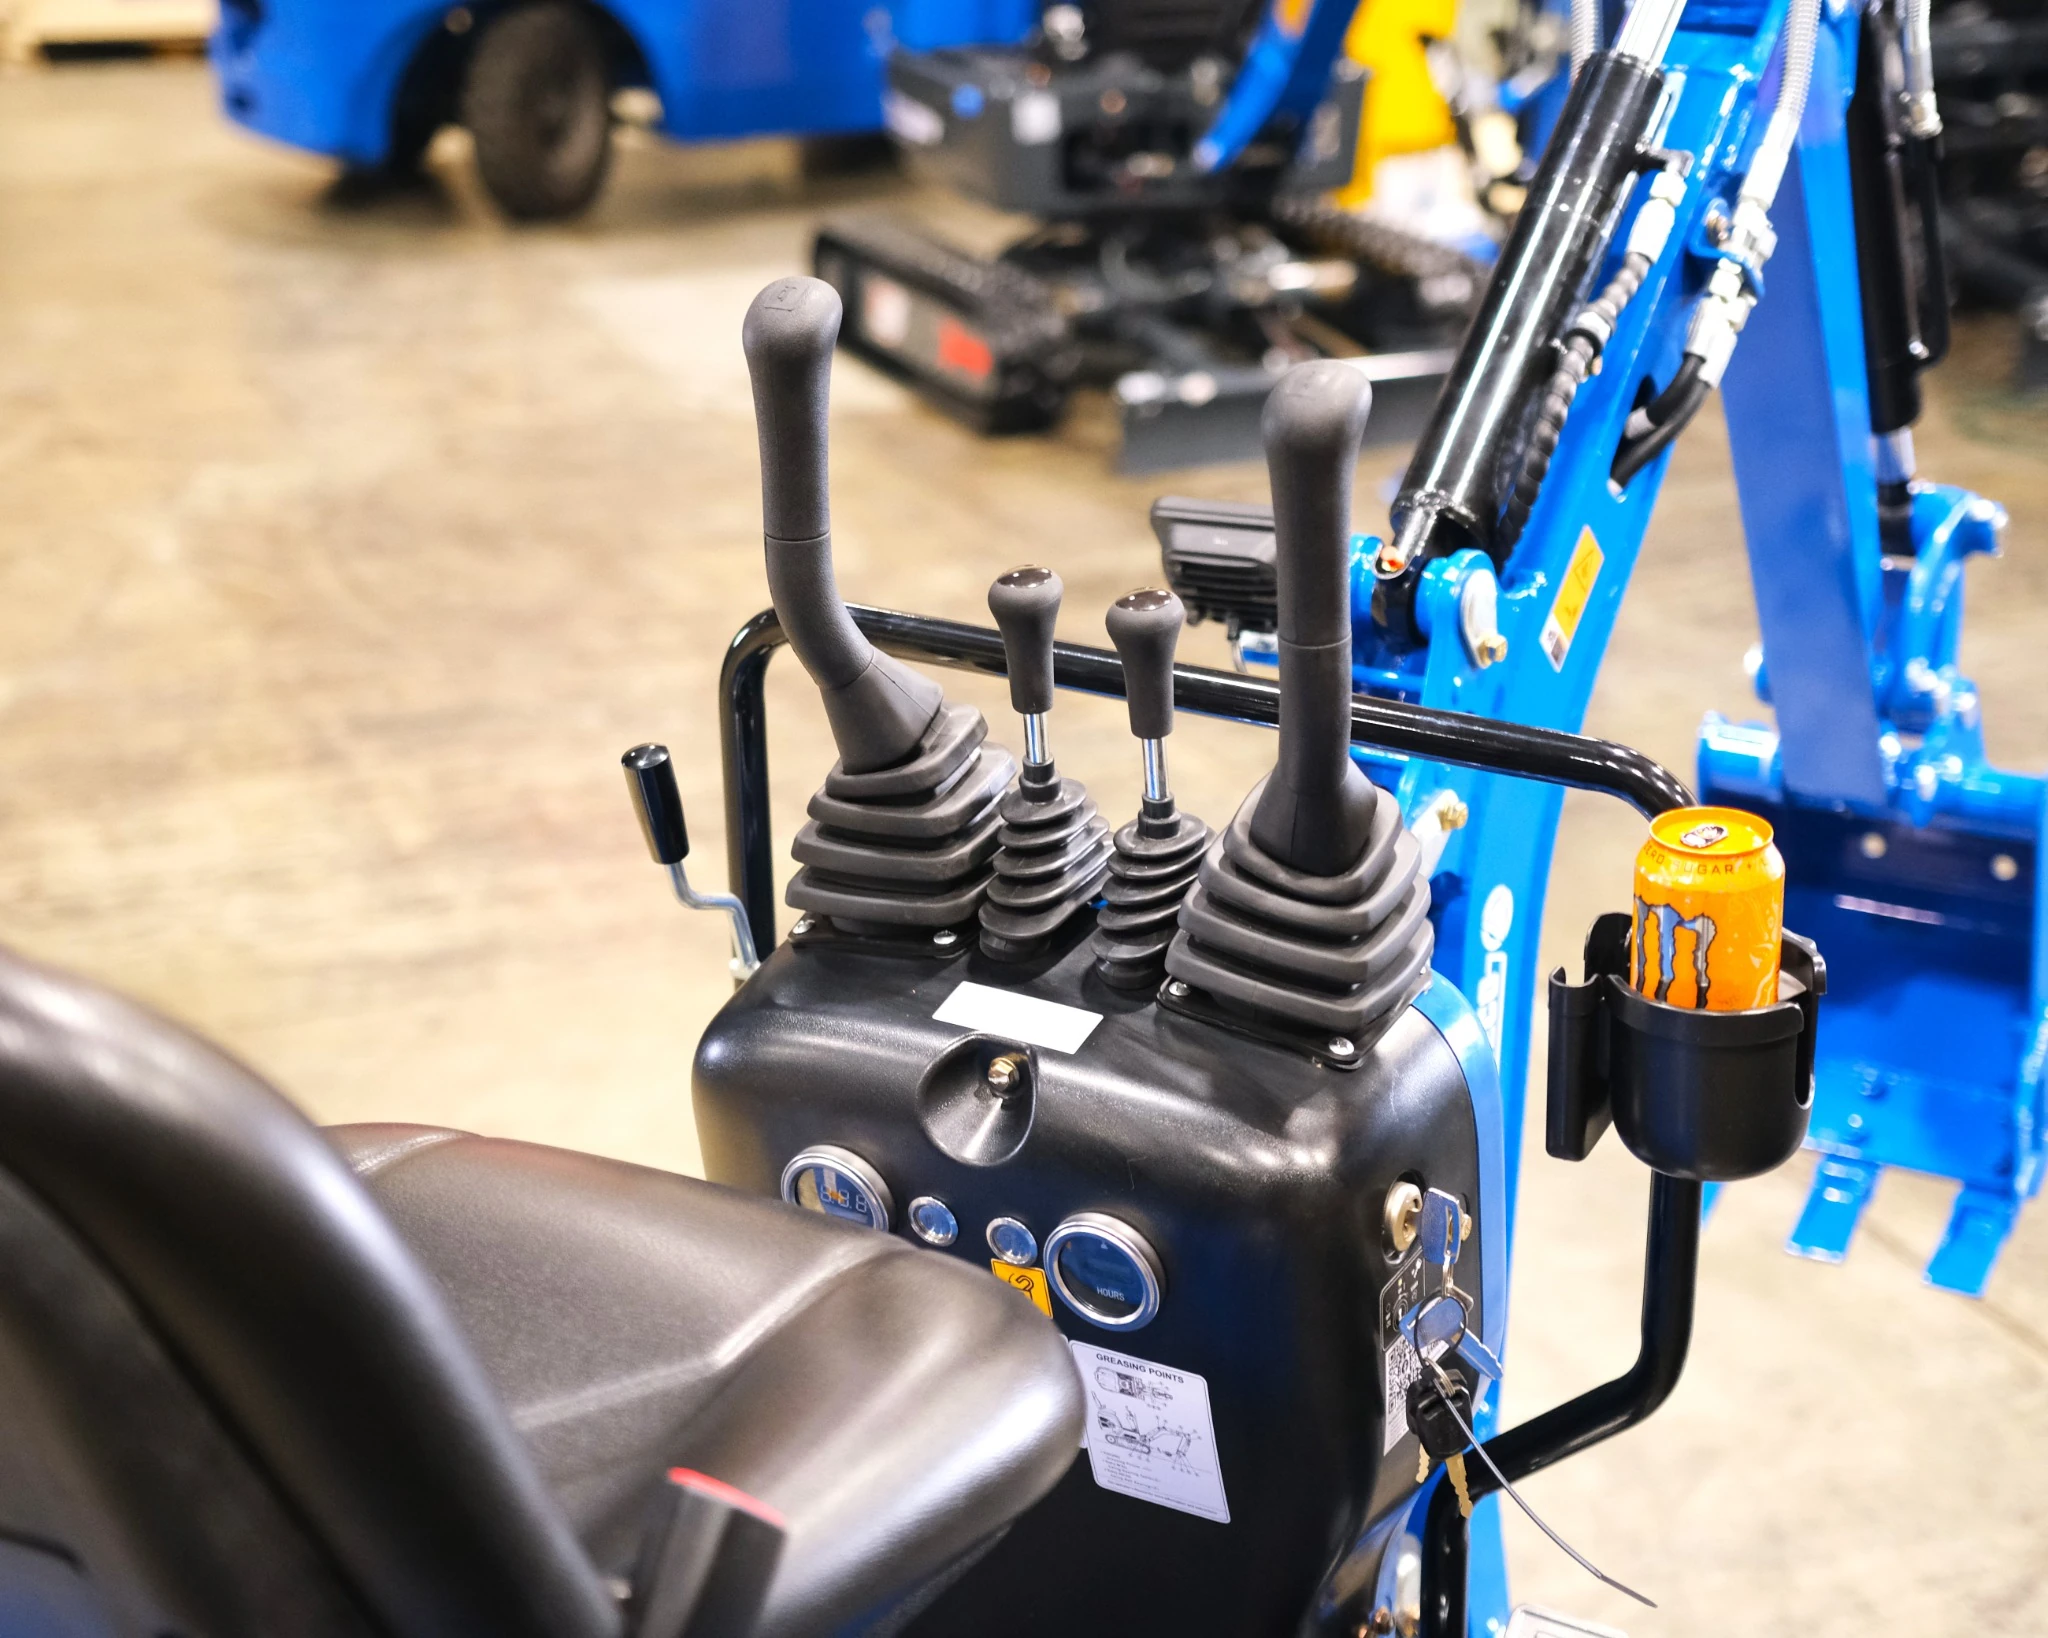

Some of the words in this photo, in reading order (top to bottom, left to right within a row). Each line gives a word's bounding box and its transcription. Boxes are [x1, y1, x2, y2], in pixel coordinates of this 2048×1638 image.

[1672, 860, 1734, 875] SUGAR
[1097, 1287, 1125, 1302] HOURS
[1096, 1353, 1146, 1373] GREASING
[1149, 1368, 1184, 1383] POINTS
